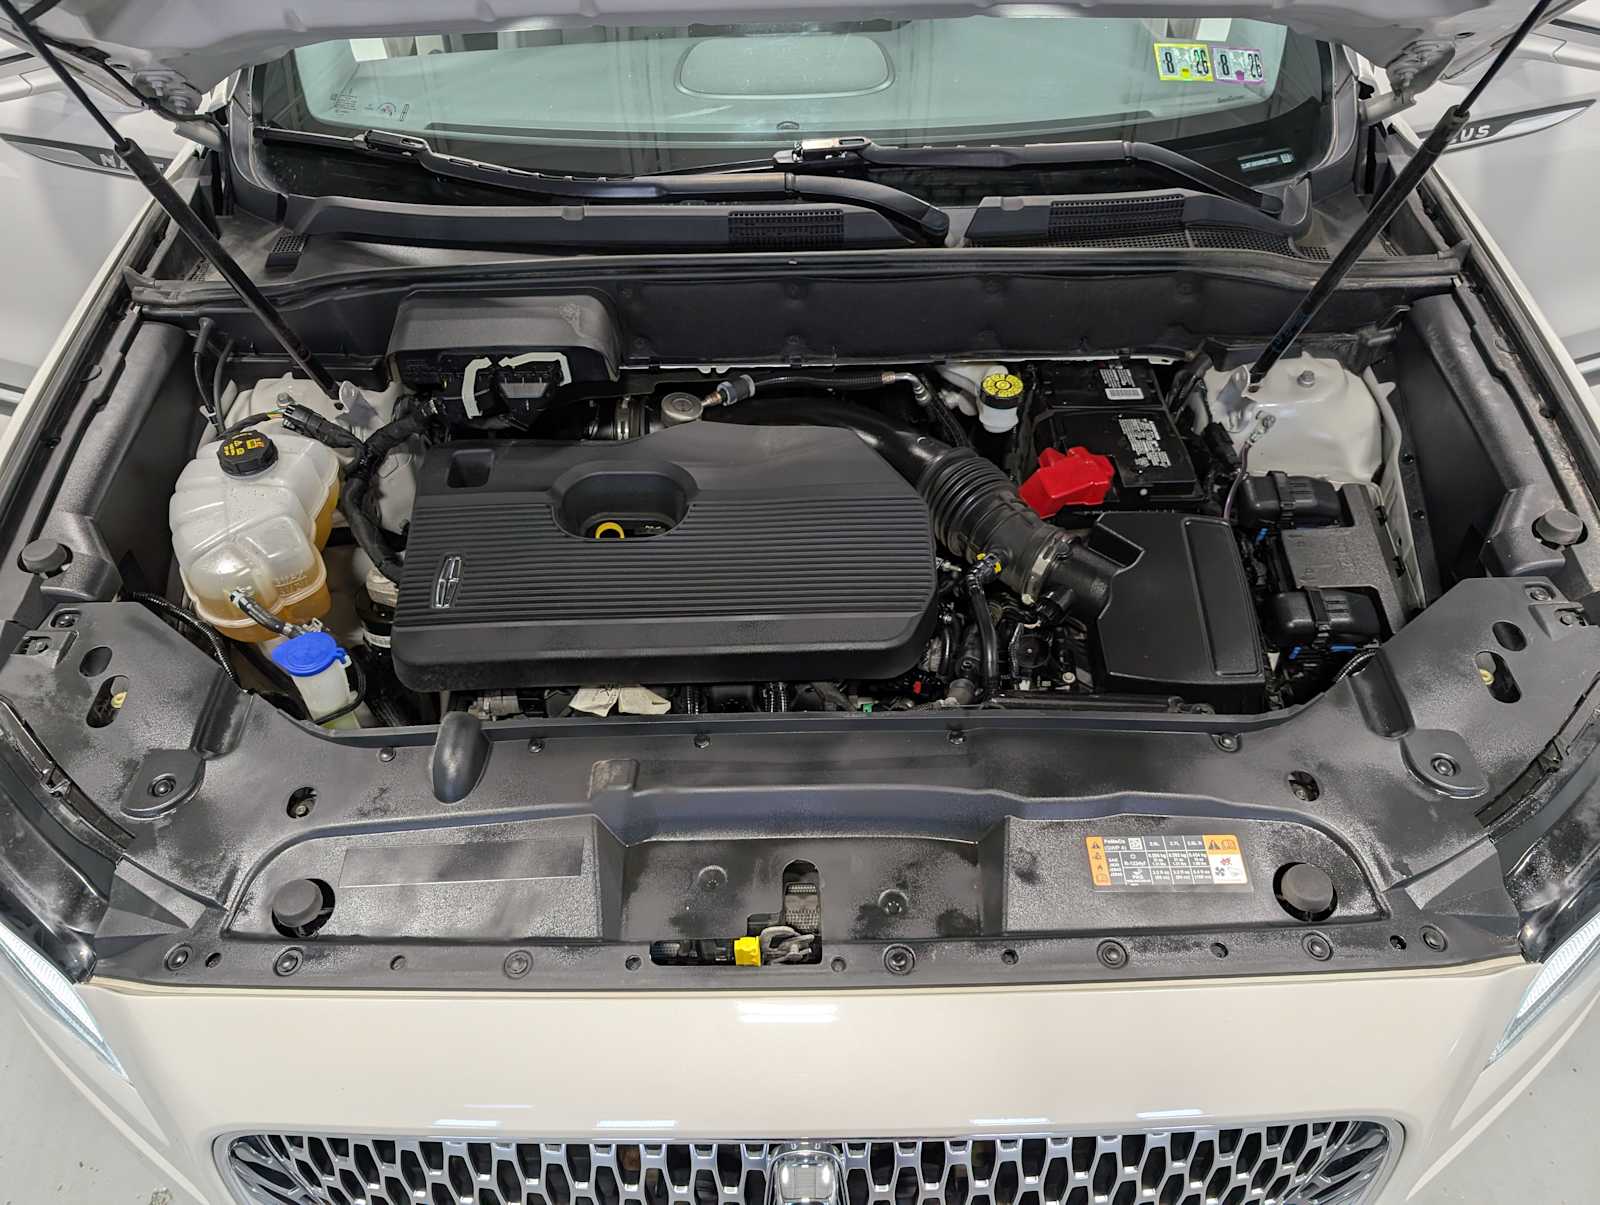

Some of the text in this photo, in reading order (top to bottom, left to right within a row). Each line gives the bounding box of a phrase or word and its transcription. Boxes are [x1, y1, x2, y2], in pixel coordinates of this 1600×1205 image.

[1164, 49, 1209, 74] 8 26
[1219, 53, 1263, 78] 8 26
